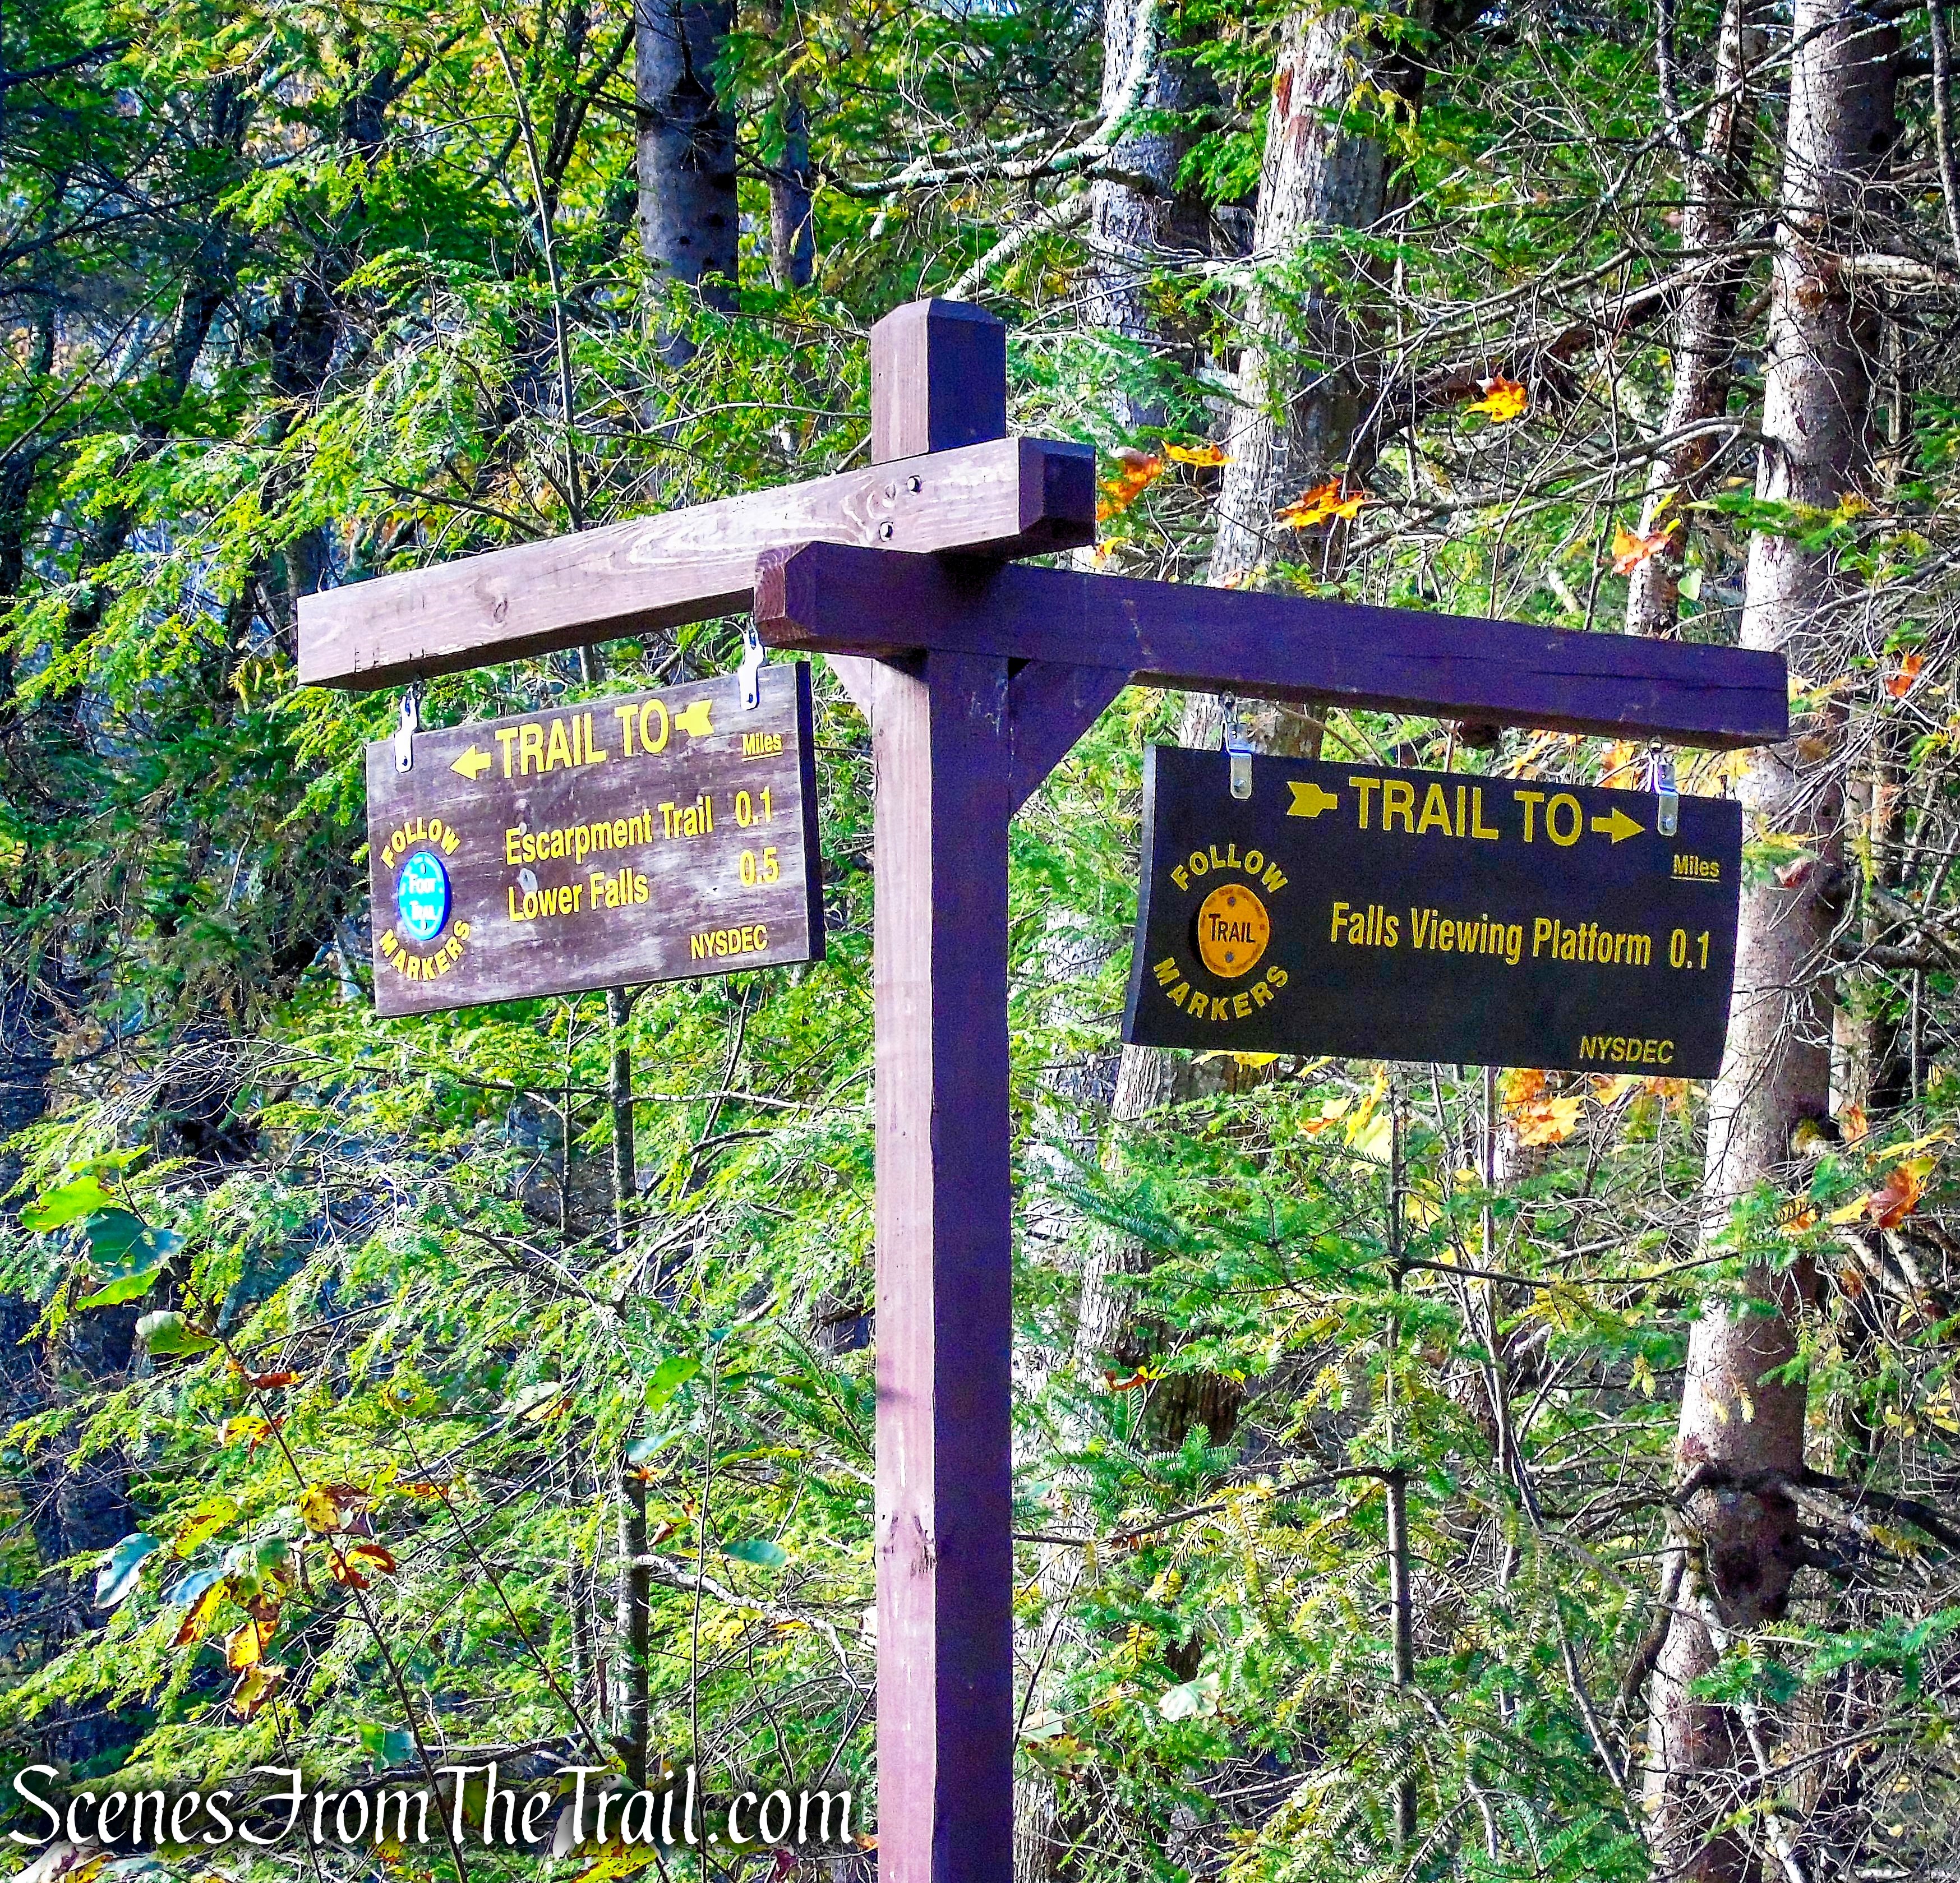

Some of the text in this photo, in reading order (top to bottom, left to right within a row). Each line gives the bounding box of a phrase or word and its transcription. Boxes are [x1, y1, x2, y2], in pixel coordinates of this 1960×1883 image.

[495, 698, 670, 779] TRAIL TO
[741, 732, 782, 756] Miles
[505, 786, 773, 865] Escarpment Trail 0.1
[1349, 777, 1583, 846] TRAIL TO
[380, 817, 460, 870] FOLLOW
[1170, 843, 1288, 893] FOLLOW
[1673, 855, 1720, 878] Miles
[508, 847, 779, 922] Lower Falls 0.5
[379, 919, 470, 982] MARKERS
[690, 925, 767, 960] NYSDEC
[1209, 914, 1255, 943] TRAIL
[1330, 902, 1710, 970] Falls Viewing Platform 0.1
[1153, 956, 1288, 1021] MARKERS
[1579, 1035, 1674, 1064] NYSDEC
